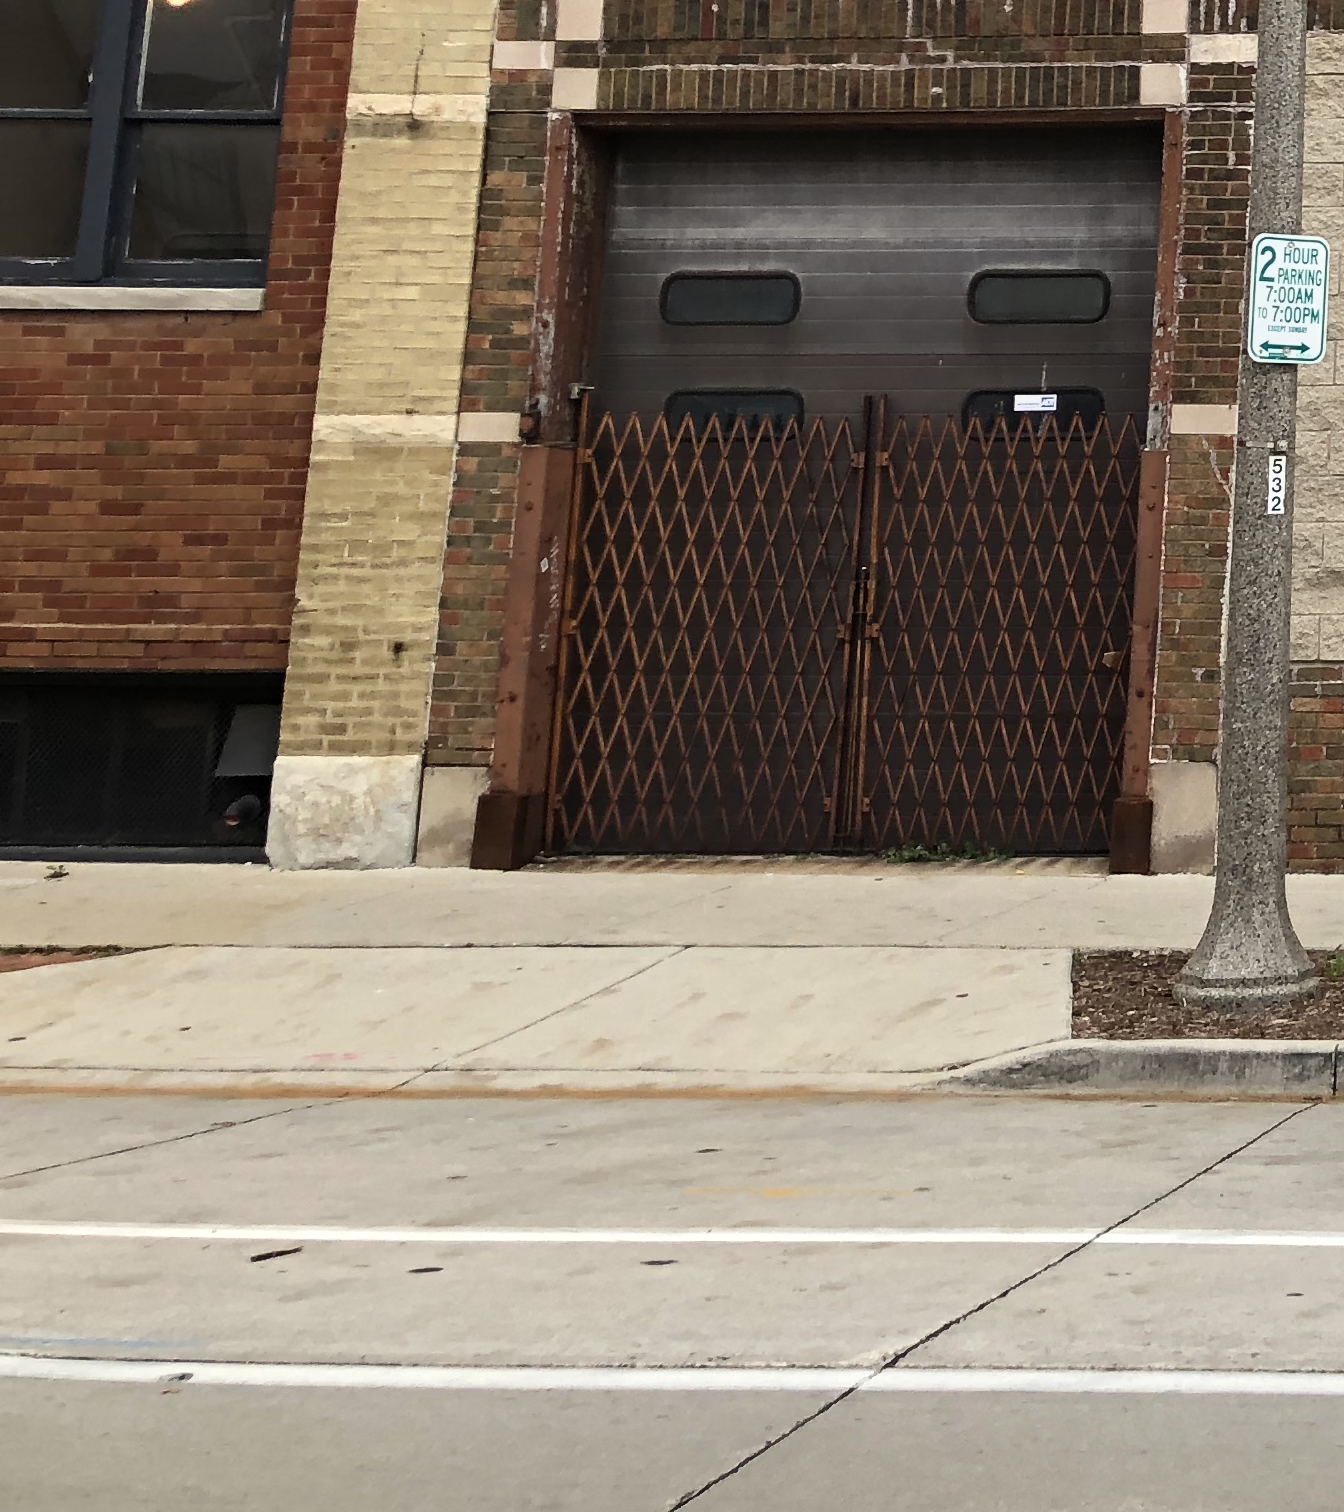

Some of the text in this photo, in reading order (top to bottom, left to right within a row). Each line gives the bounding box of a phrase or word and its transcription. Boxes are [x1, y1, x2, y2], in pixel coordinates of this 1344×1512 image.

[1259, 245, 1319, 283] 2 HOUR
[1277, 268, 1323, 287] PARKING
[1266, 285, 1314, 305] 7:00AM
[1257, 305, 1320, 324] TO 7:00PM
